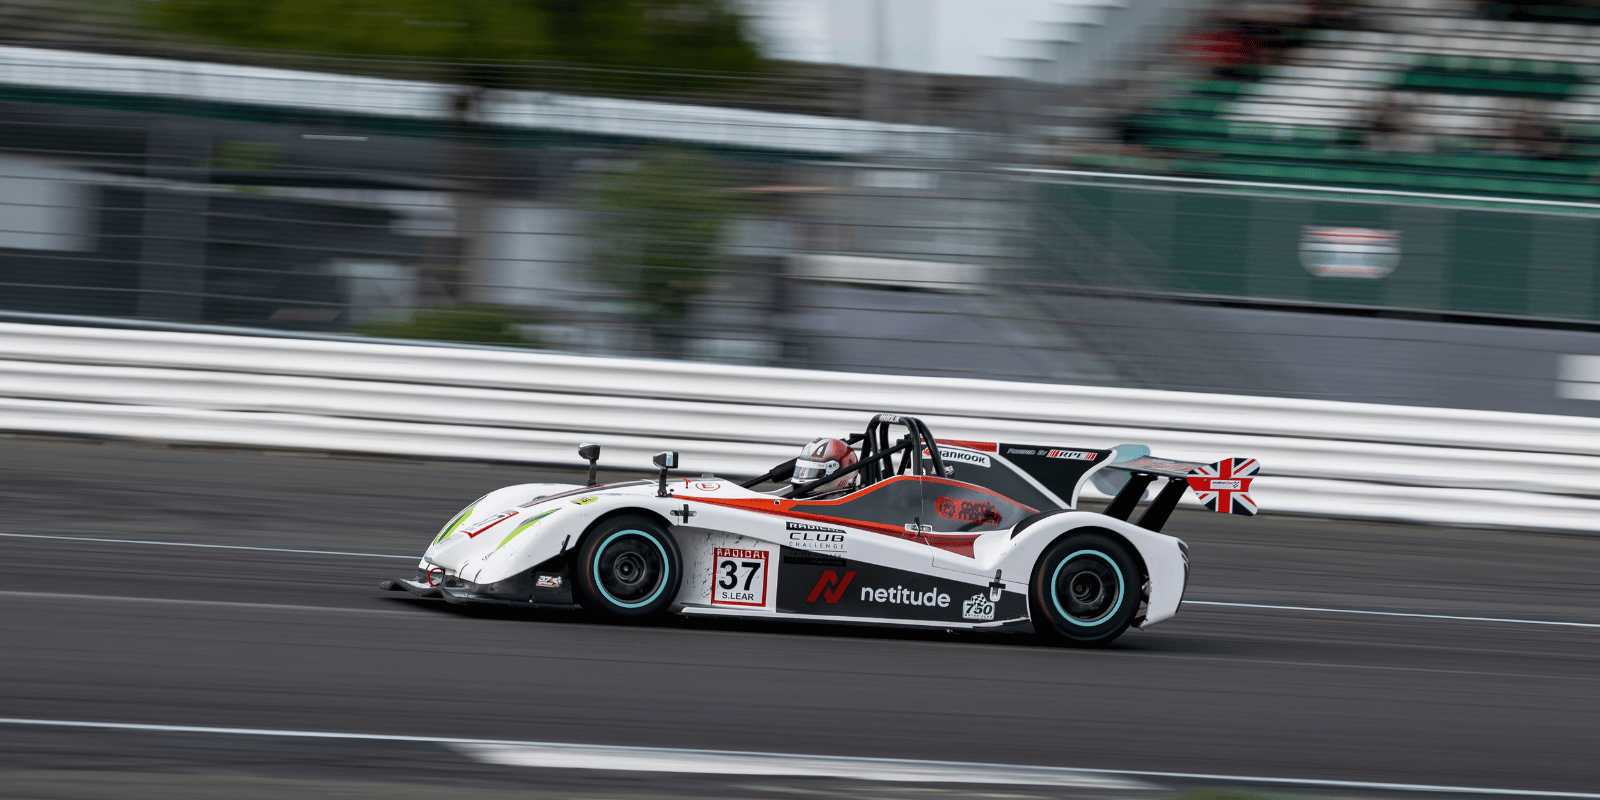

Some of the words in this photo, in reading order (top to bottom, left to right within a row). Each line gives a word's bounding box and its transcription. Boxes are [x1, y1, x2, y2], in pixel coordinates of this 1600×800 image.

[789, 532, 845, 543] CLUB
[788, 541, 845, 550] CHALLENGE
[717, 548, 767, 559] RADICAL
[718, 560, 762, 591] 37
[722, 591, 755, 601] S.LEAR
[860, 585, 951, 608] netitude
[965, 602, 993, 615] 750
